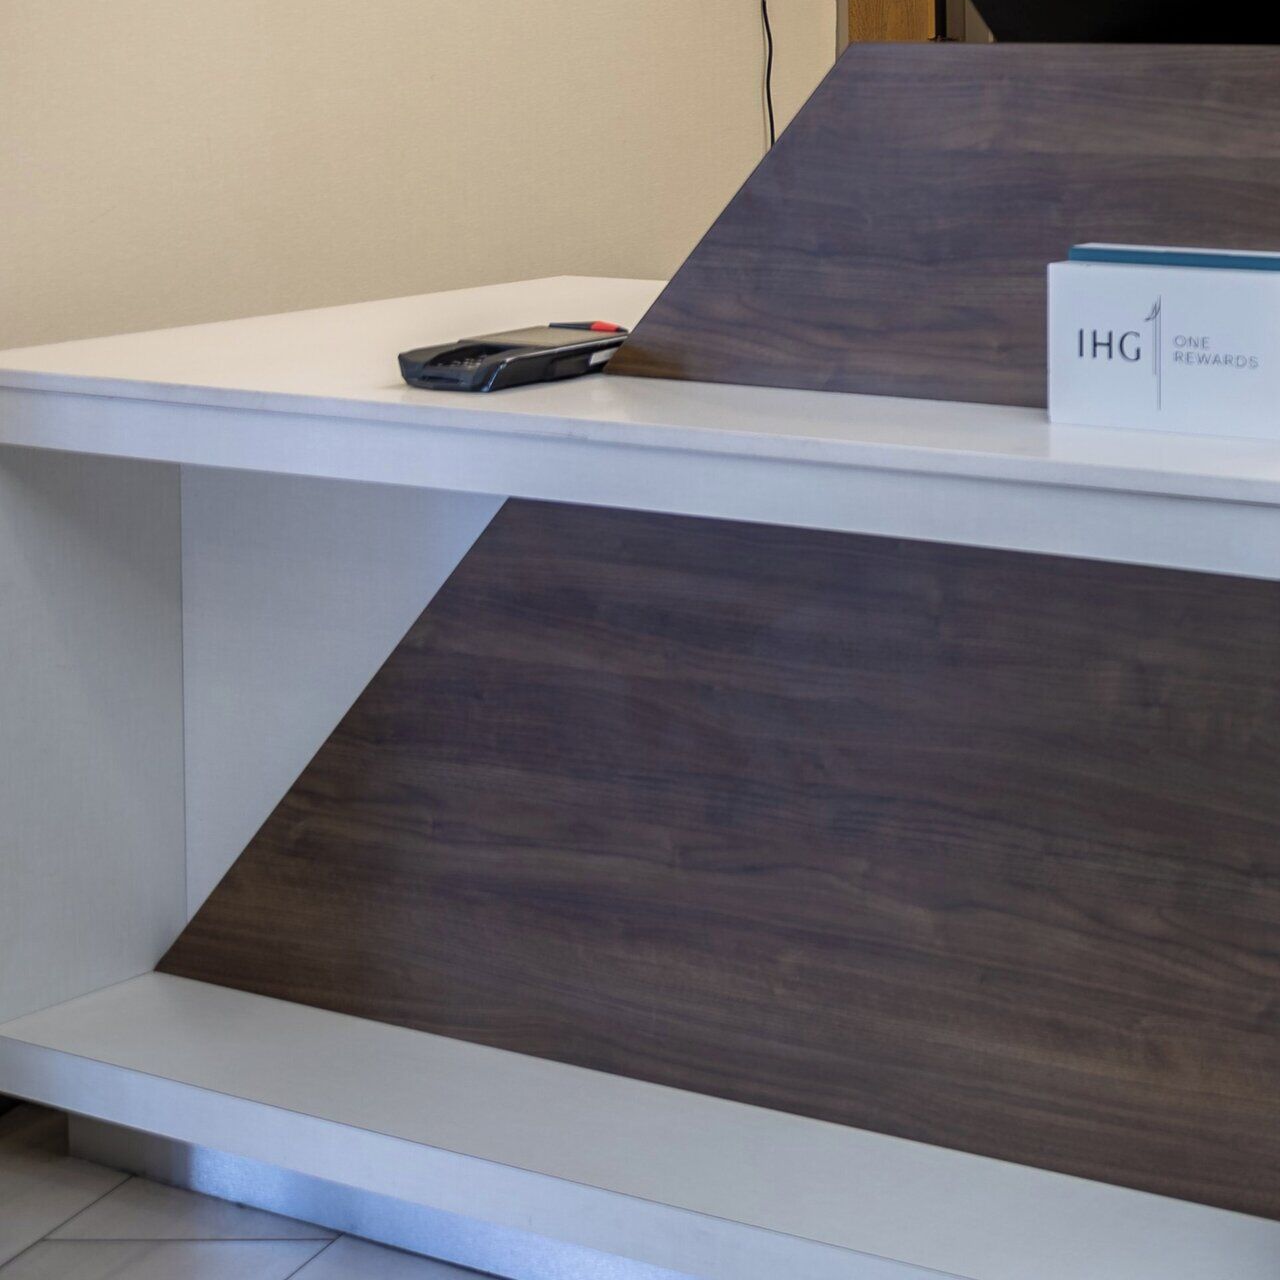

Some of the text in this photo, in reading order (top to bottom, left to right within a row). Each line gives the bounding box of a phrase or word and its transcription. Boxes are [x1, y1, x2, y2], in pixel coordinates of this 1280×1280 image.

[1078, 328, 1211, 362] IHG ONE
[1173, 351, 1260, 370] REWARDS
